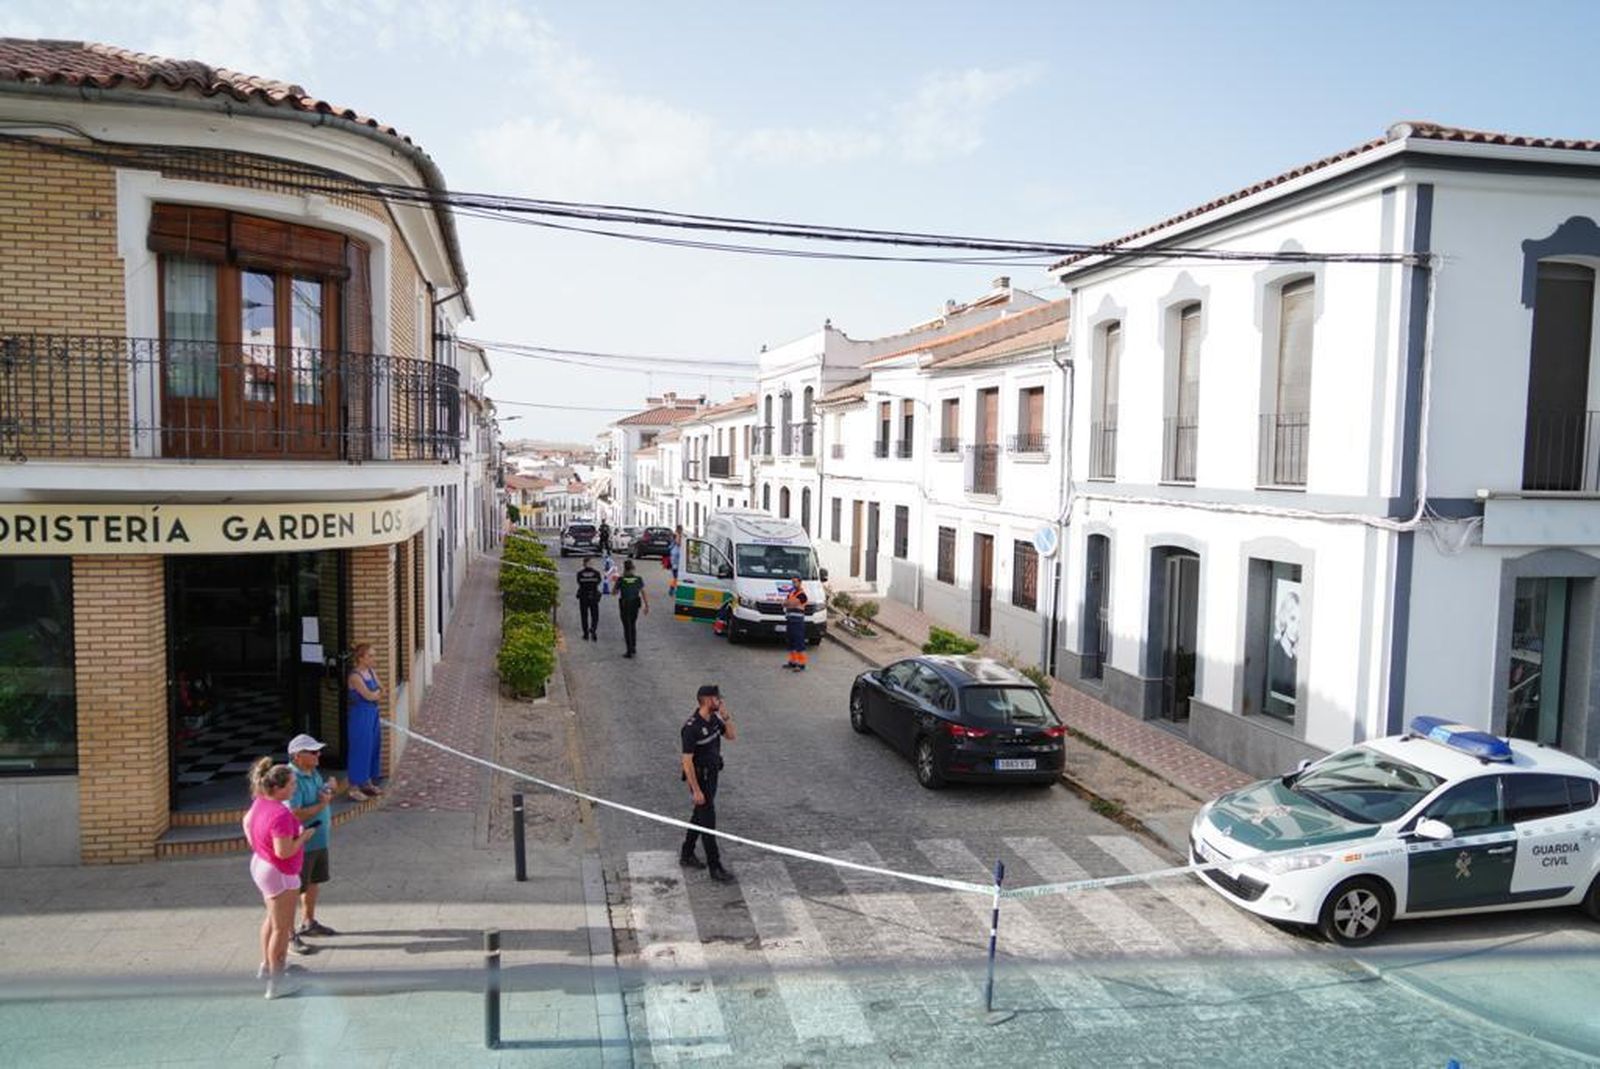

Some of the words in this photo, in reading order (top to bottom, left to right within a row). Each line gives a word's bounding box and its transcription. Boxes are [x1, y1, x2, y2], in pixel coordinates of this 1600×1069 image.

[222, 513, 354, 541] GARDEN
[371, 510, 402, 535] LOS
[1532, 843, 1580, 856] GUARDIA
[1541, 858, 1569, 868] CIVIL
